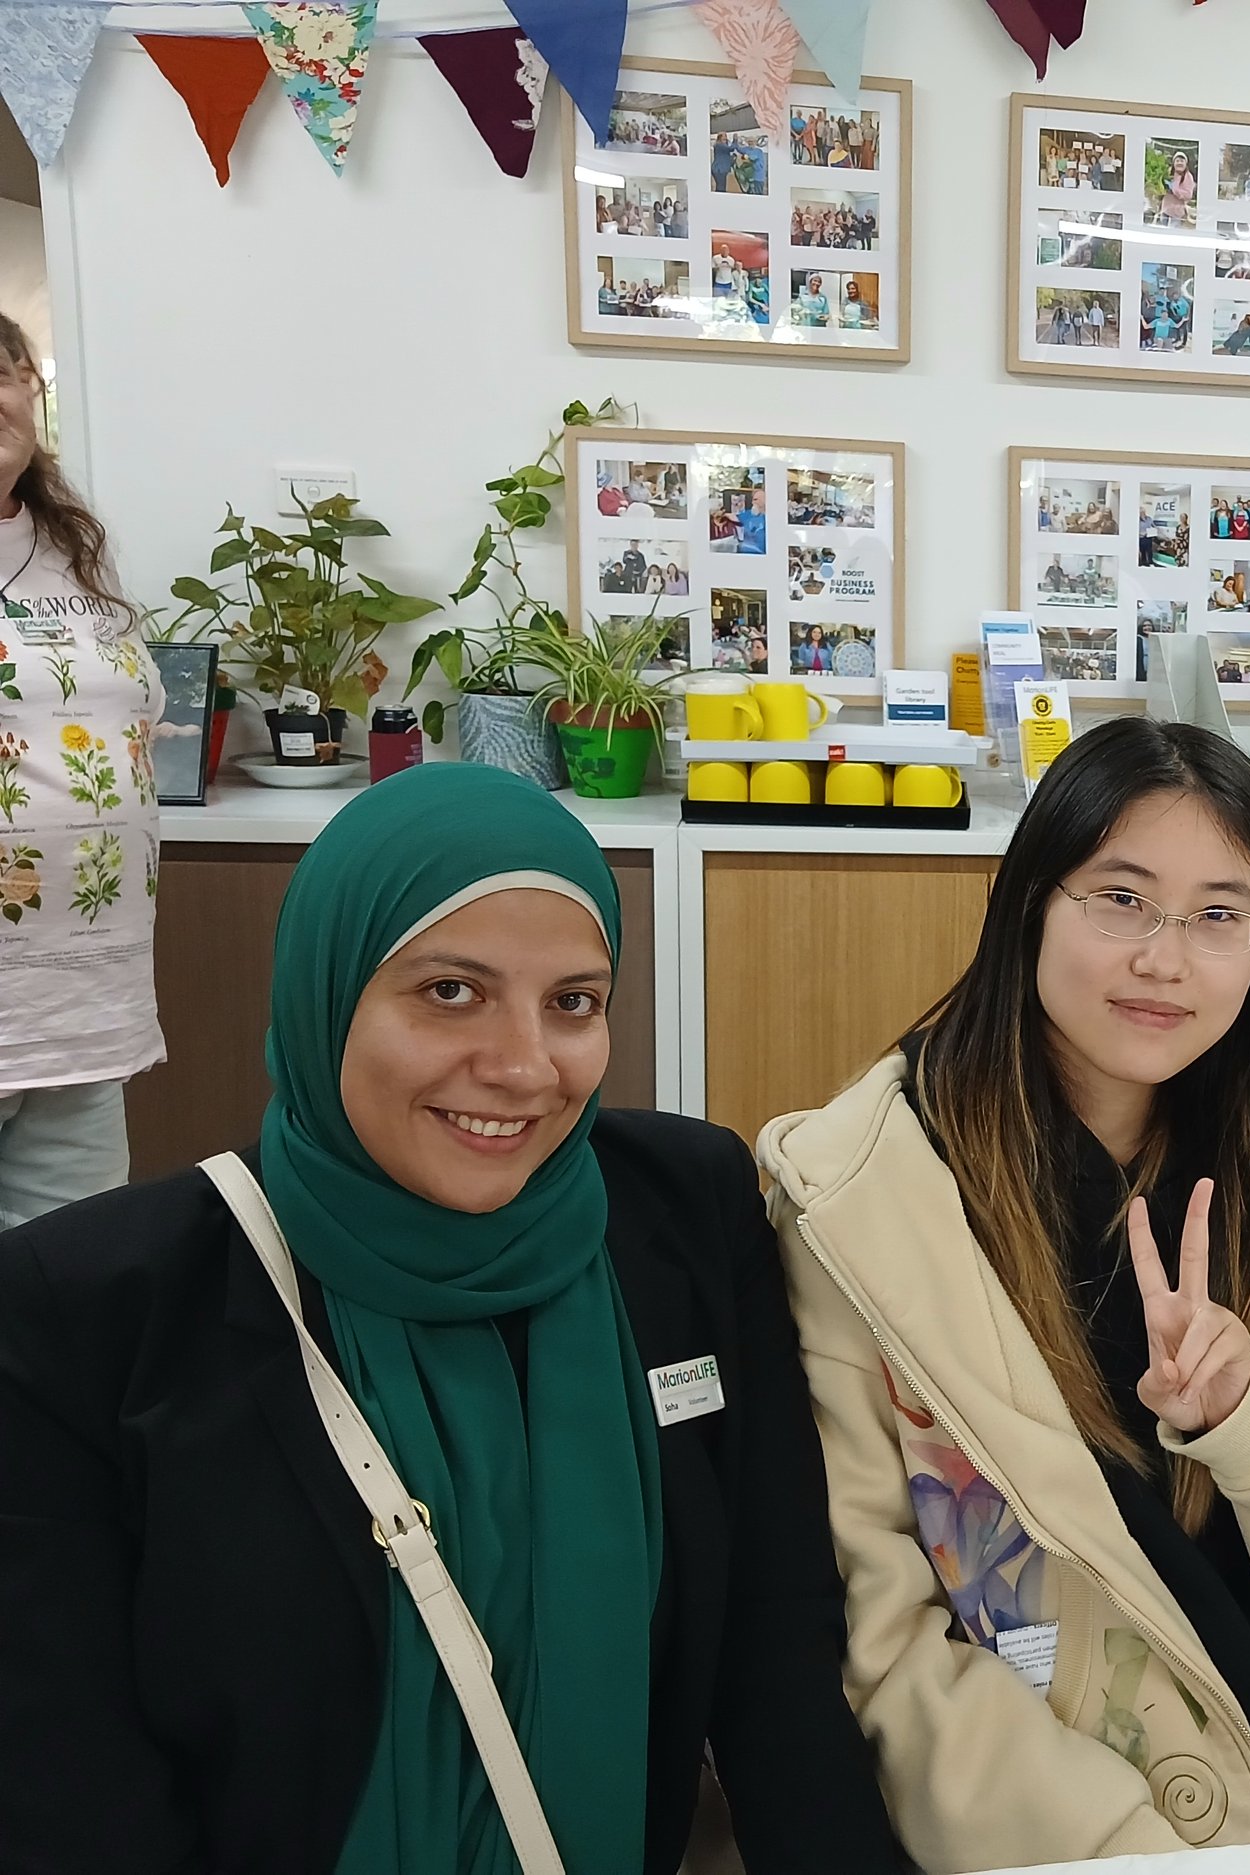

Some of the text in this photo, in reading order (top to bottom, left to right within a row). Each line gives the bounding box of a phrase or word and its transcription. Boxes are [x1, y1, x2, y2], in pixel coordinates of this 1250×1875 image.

[1156, 501, 1175, 511] ACE
[831, 579, 874, 588] BUSINESS
[829, 586, 876, 596] PROGRAM
[656, 1361, 717, 1390] MarionLIFE
